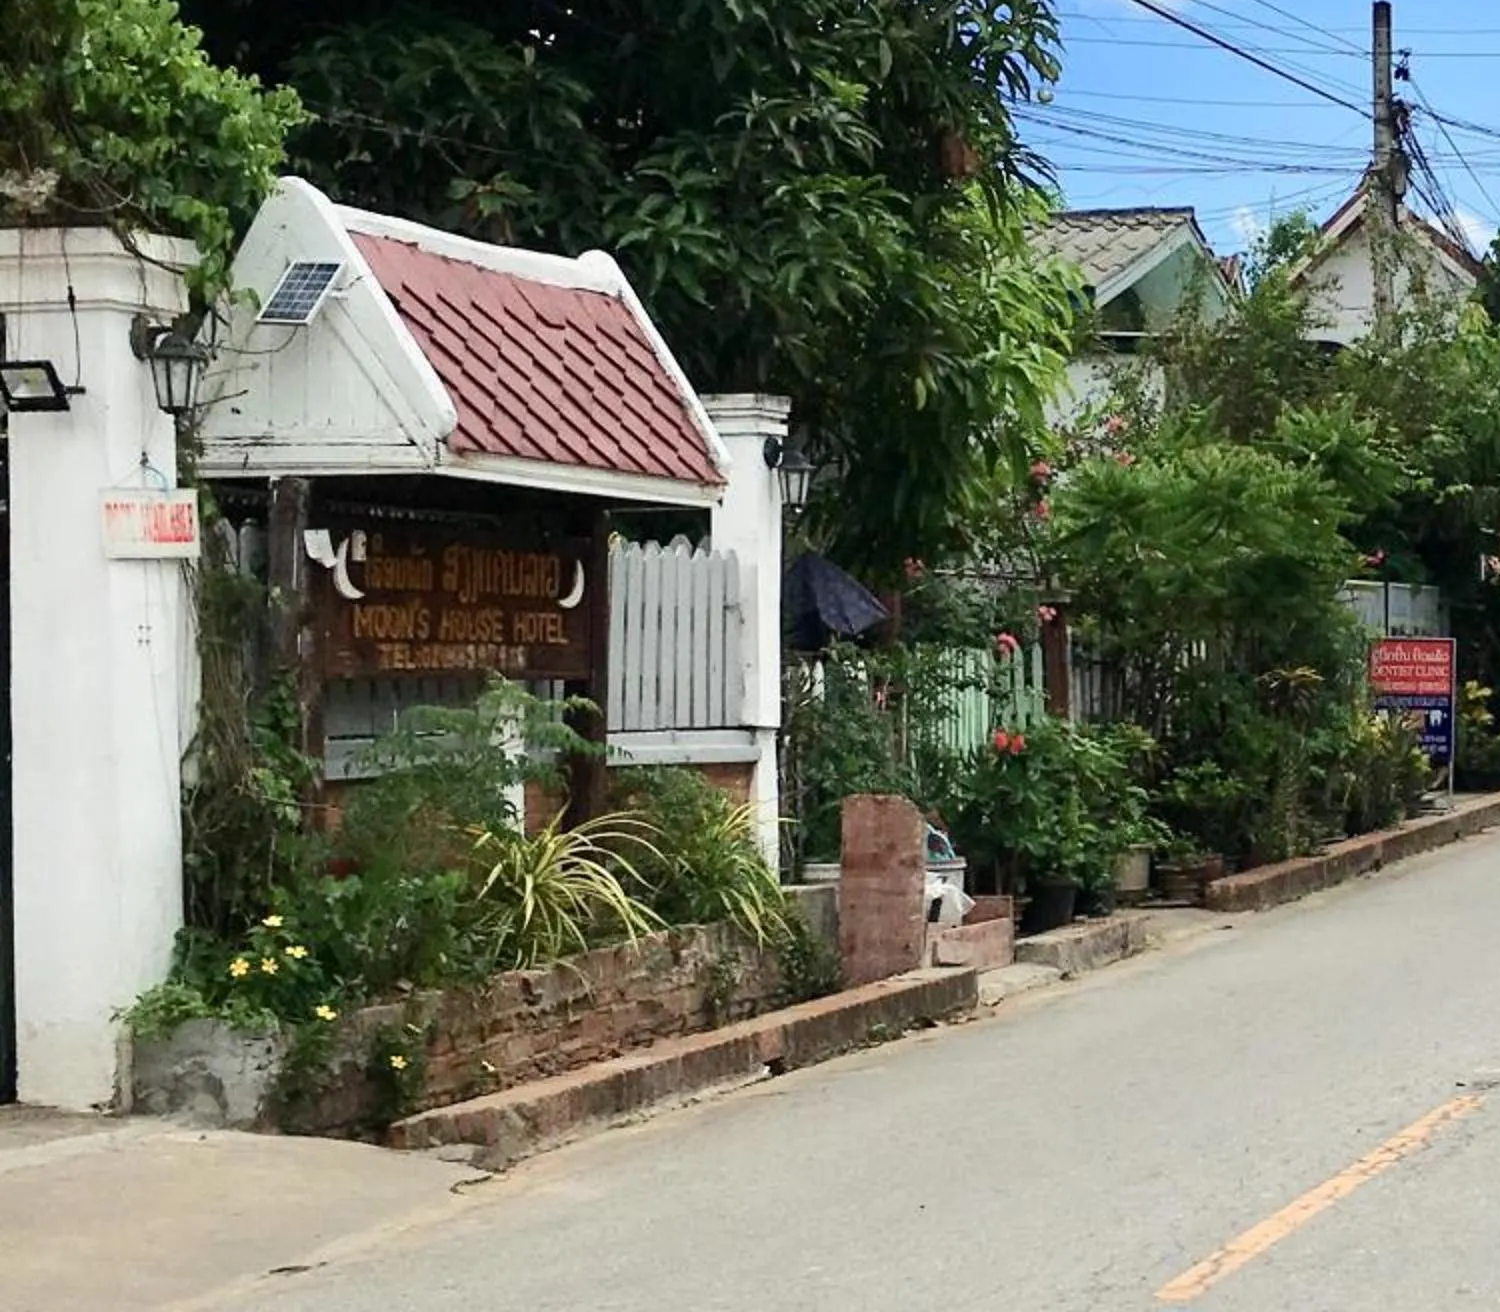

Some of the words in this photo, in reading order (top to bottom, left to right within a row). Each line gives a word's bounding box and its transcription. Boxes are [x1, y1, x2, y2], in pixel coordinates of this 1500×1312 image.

[353, 601, 430, 639] MOON'S
[439, 610, 504, 641] HOUSE
[513, 612, 569, 643] HOTEL
